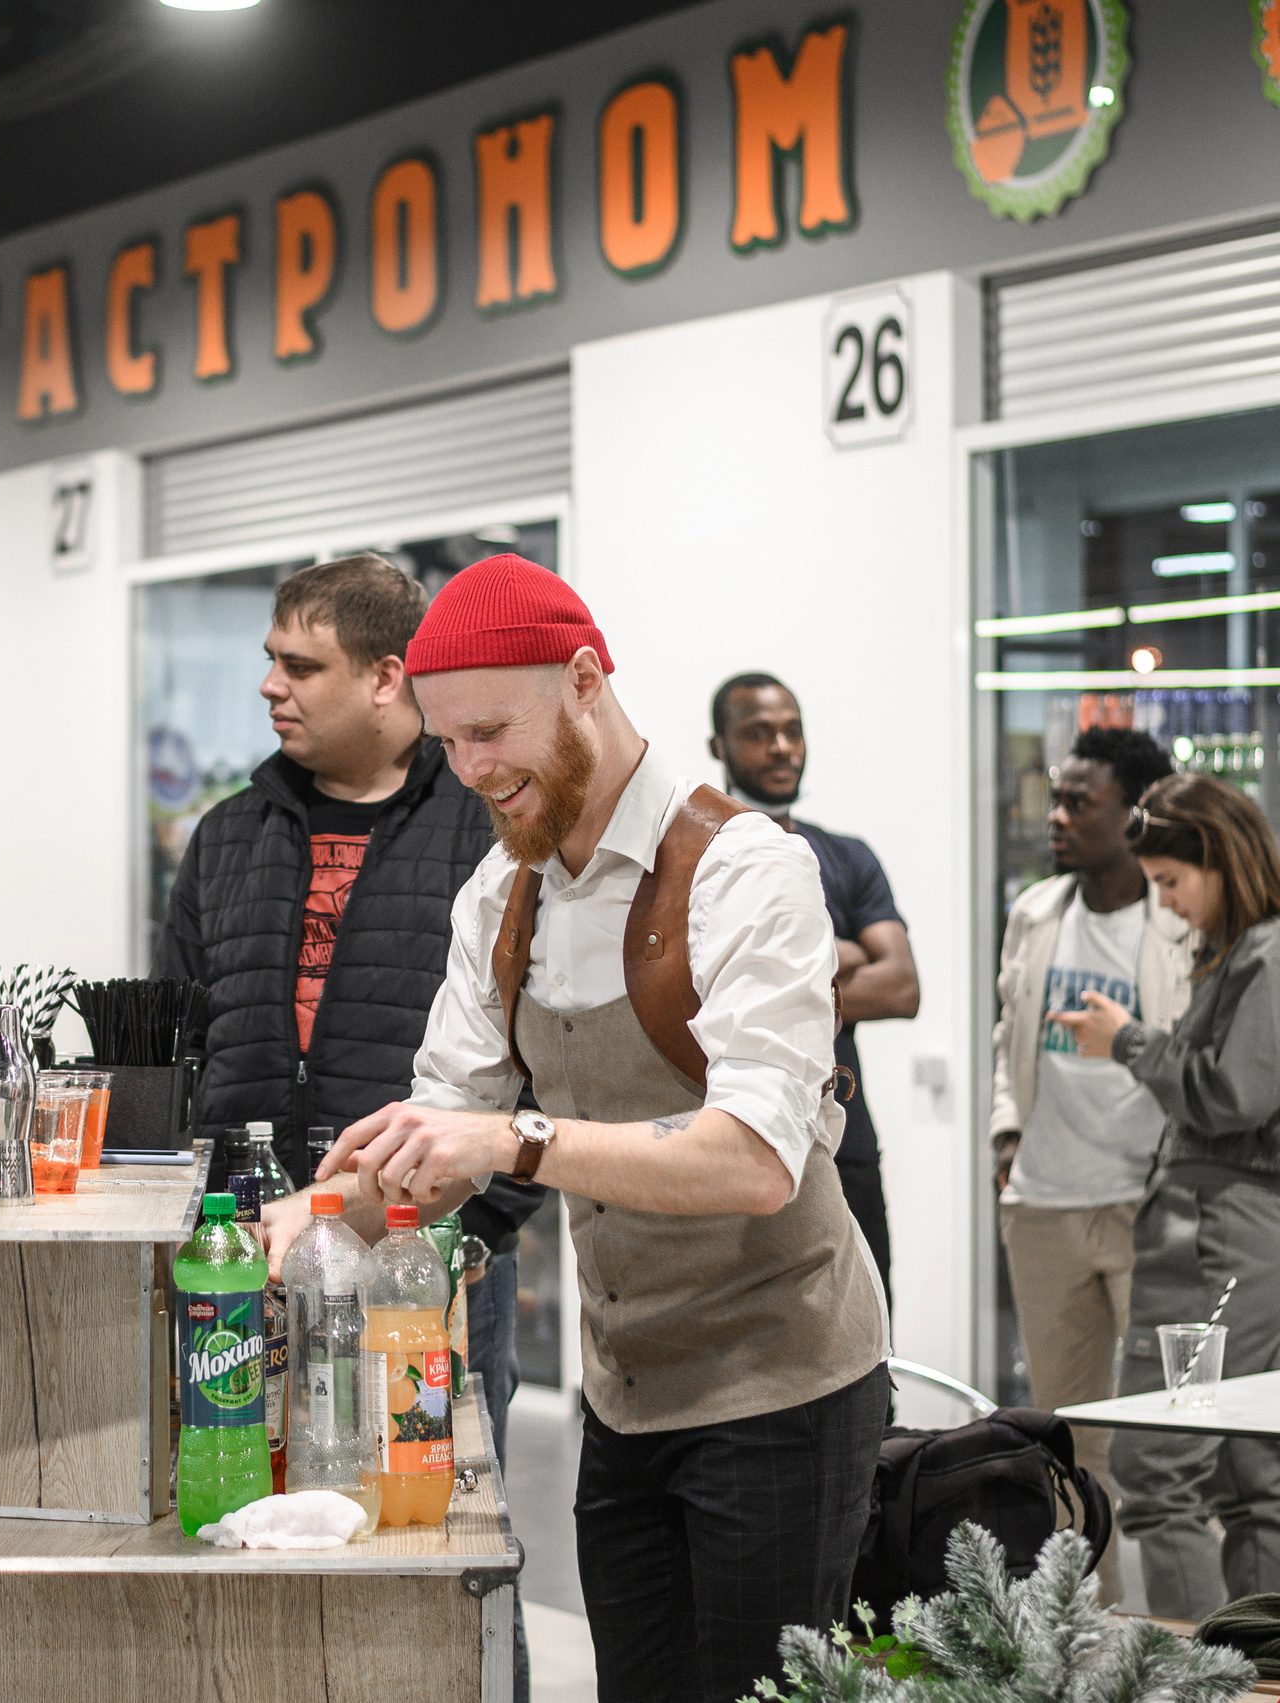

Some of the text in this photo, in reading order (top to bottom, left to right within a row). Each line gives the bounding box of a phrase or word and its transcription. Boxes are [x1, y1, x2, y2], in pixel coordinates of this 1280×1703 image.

[833, 316, 904, 423] 26
[53, 481, 93, 557] 27
[188, 1334, 264, 1384] Мохито
[265, 1344, 288, 1369] ERO
[421, 1450, 454, 1464] АПЕЛЬС
